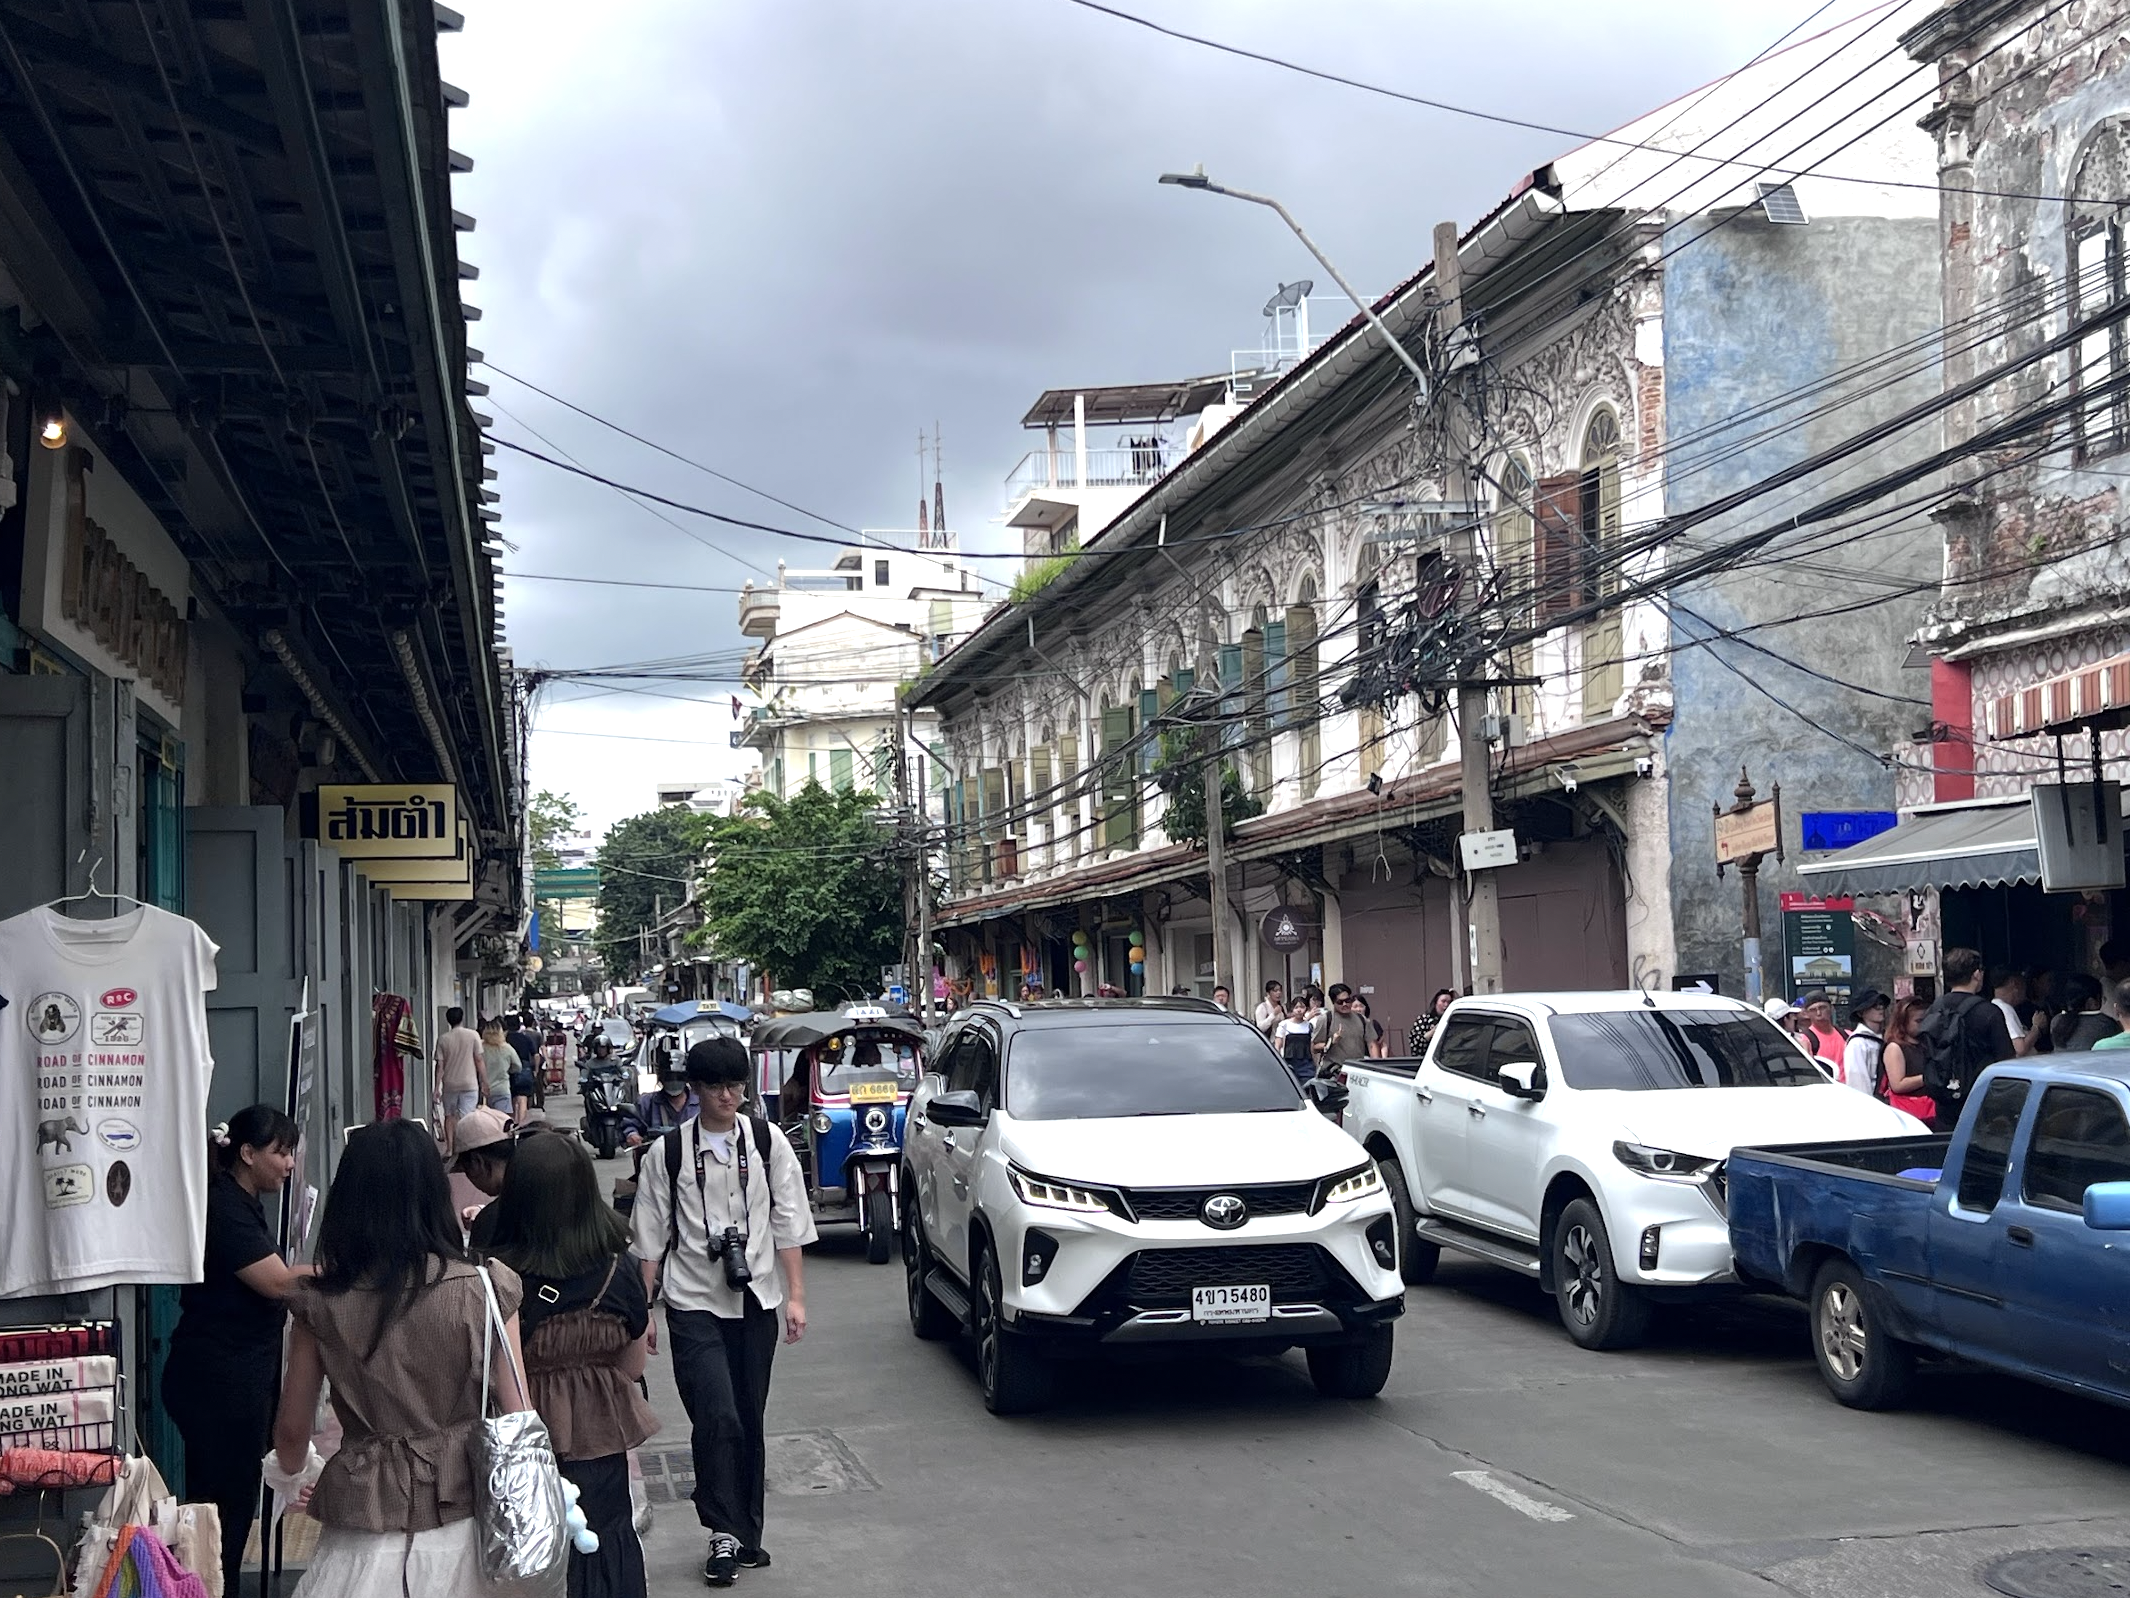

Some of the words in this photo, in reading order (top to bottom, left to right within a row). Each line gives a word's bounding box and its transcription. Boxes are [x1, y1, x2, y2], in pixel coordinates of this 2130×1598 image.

[328, 795, 445, 840] ส้มตำ
[37, 1055, 67, 1068] ROAD
[72, 1054, 82, 1065] OF
[87, 1054, 145, 1066] CINNAMON
[72, 1075, 82, 1086] OF
[87, 1075, 143, 1087] CINNAMON
[72, 1096, 82, 1107] OF
[87, 1095, 141, 1108] CINNAMON
[1230, 1287, 1268, 1304] 5480
[0, 1370, 40, 1384] ADE
[46, 1367, 63, 1380] IN
[36, 1379, 73, 1393] WAT
[41, 1402, 58, 1416] IN
[30, 1414, 67, 1429] WAT
